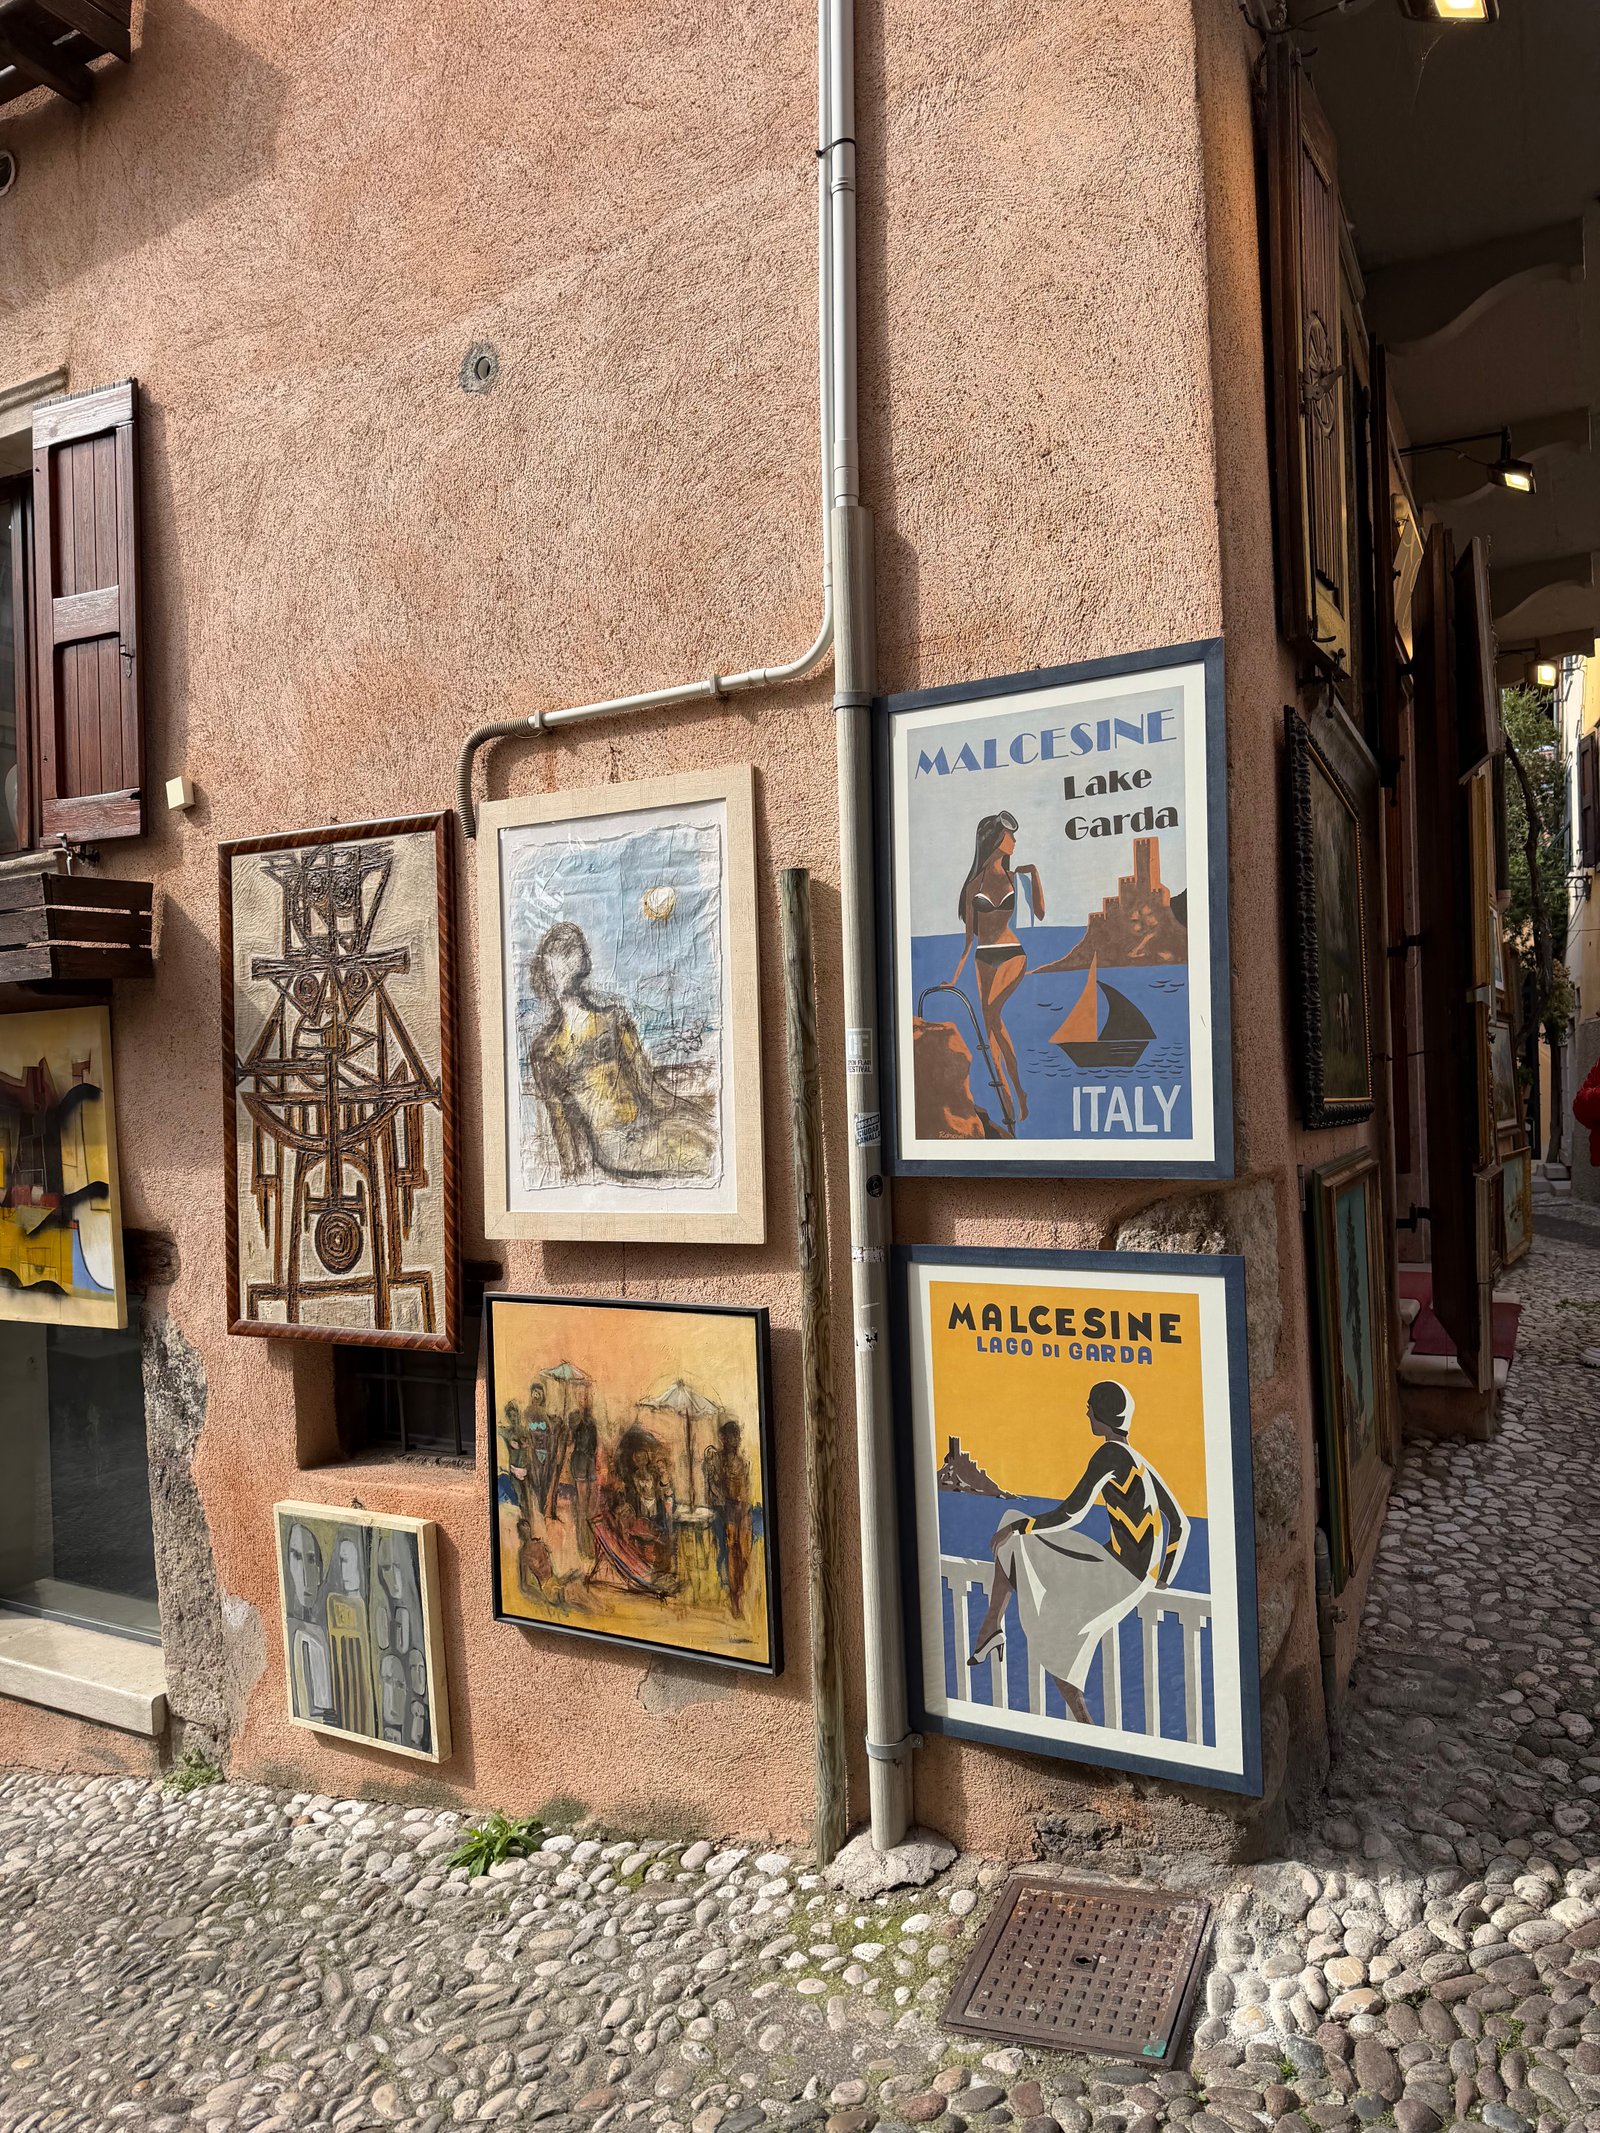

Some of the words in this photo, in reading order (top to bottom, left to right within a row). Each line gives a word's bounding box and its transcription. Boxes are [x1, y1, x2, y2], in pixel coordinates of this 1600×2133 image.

[915, 709, 1177, 779] MALCESINE
[1064, 768, 1152, 800] Lake
[1064, 806, 1179, 841] Garda
[1073, 1085, 1181, 1132] ITALY
[948, 1302, 1182, 1344] MALCESINE
[977, 1336, 1033, 1356] LAGO
[1042, 1343, 1060, 1357] DI
[1069, 1342, 1153, 1365] GARDA
